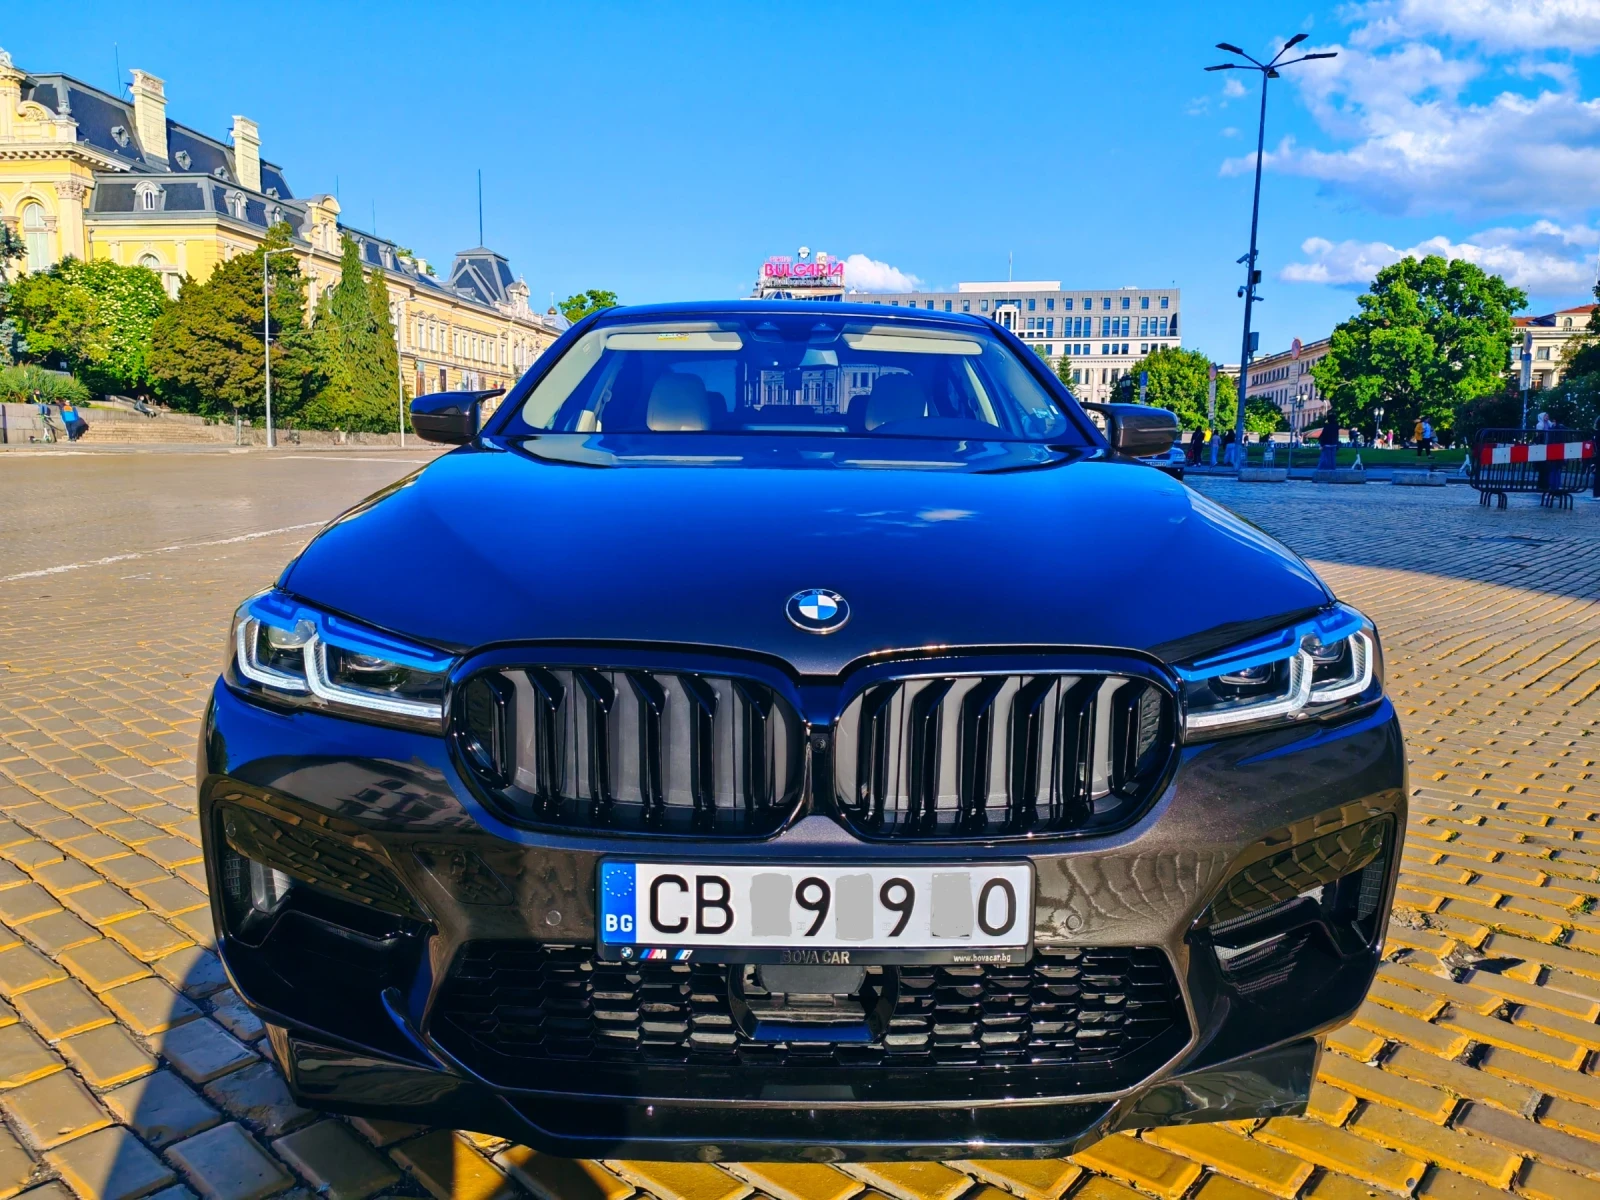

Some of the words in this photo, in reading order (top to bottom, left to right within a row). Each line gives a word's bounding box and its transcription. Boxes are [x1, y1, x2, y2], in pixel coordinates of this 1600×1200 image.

[764, 263, 844, 277] BULGARIA
[605, 913, 633, 933] BG
[822, 950, 850, 964] CAR
[953, 953, 1011, 962] www.bovacar.bg
